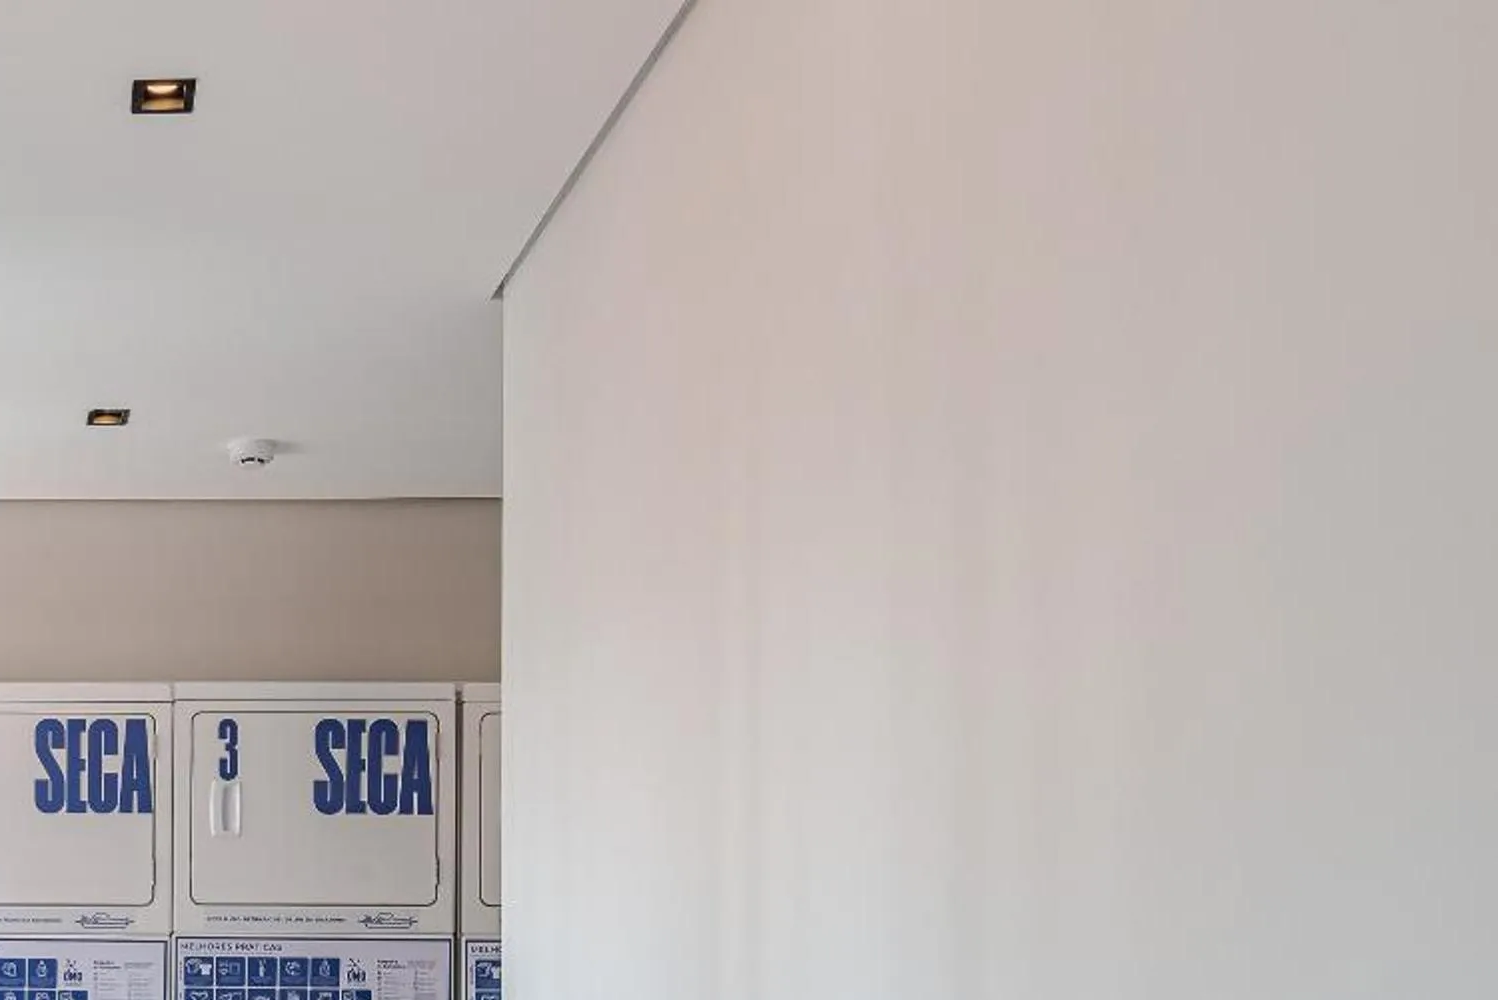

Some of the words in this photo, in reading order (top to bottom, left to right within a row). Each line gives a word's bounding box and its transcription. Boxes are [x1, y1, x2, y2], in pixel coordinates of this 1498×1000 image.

[34, 719, 153, 814] SECA
[218, 718, 238, 780] 3
[313, 719, 434, 815] SECA
